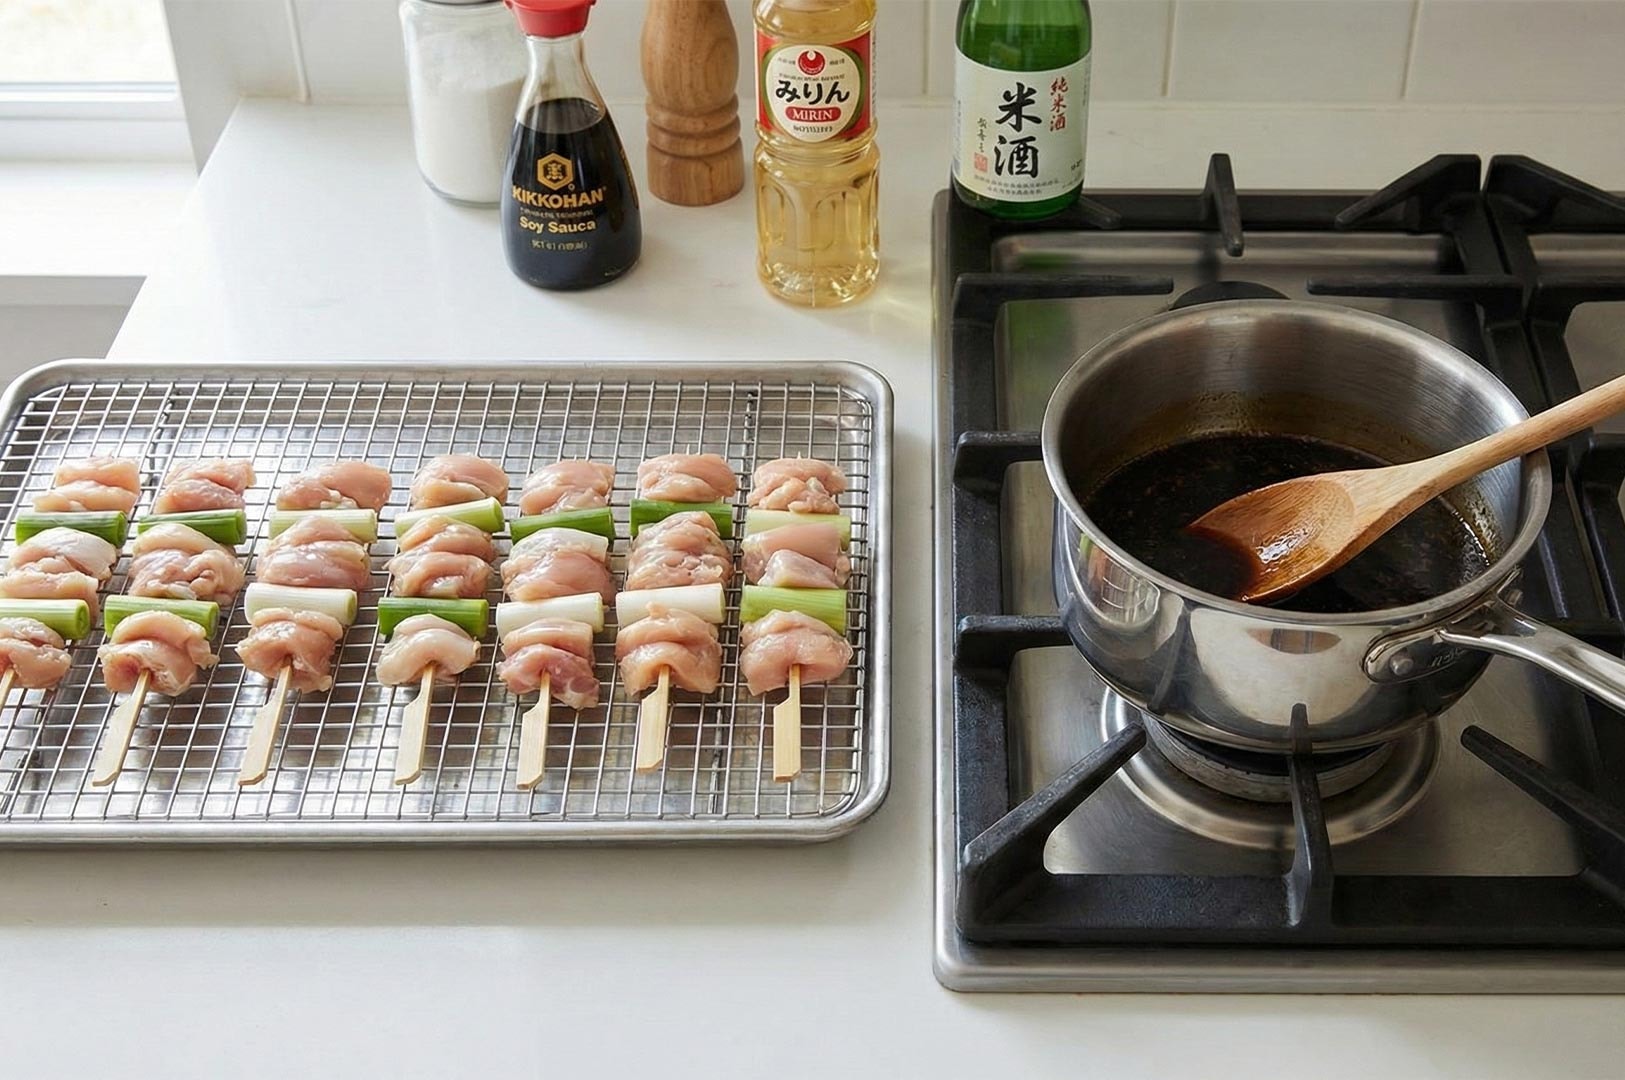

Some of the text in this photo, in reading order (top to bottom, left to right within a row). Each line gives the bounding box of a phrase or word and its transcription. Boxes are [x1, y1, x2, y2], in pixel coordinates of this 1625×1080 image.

[775, 80, 850, 105] みりん
[792, 108, 833, 121] MIRIN
[994, 81, 1042, 179] 米酒
[519, 216, 544, 234] Soy
